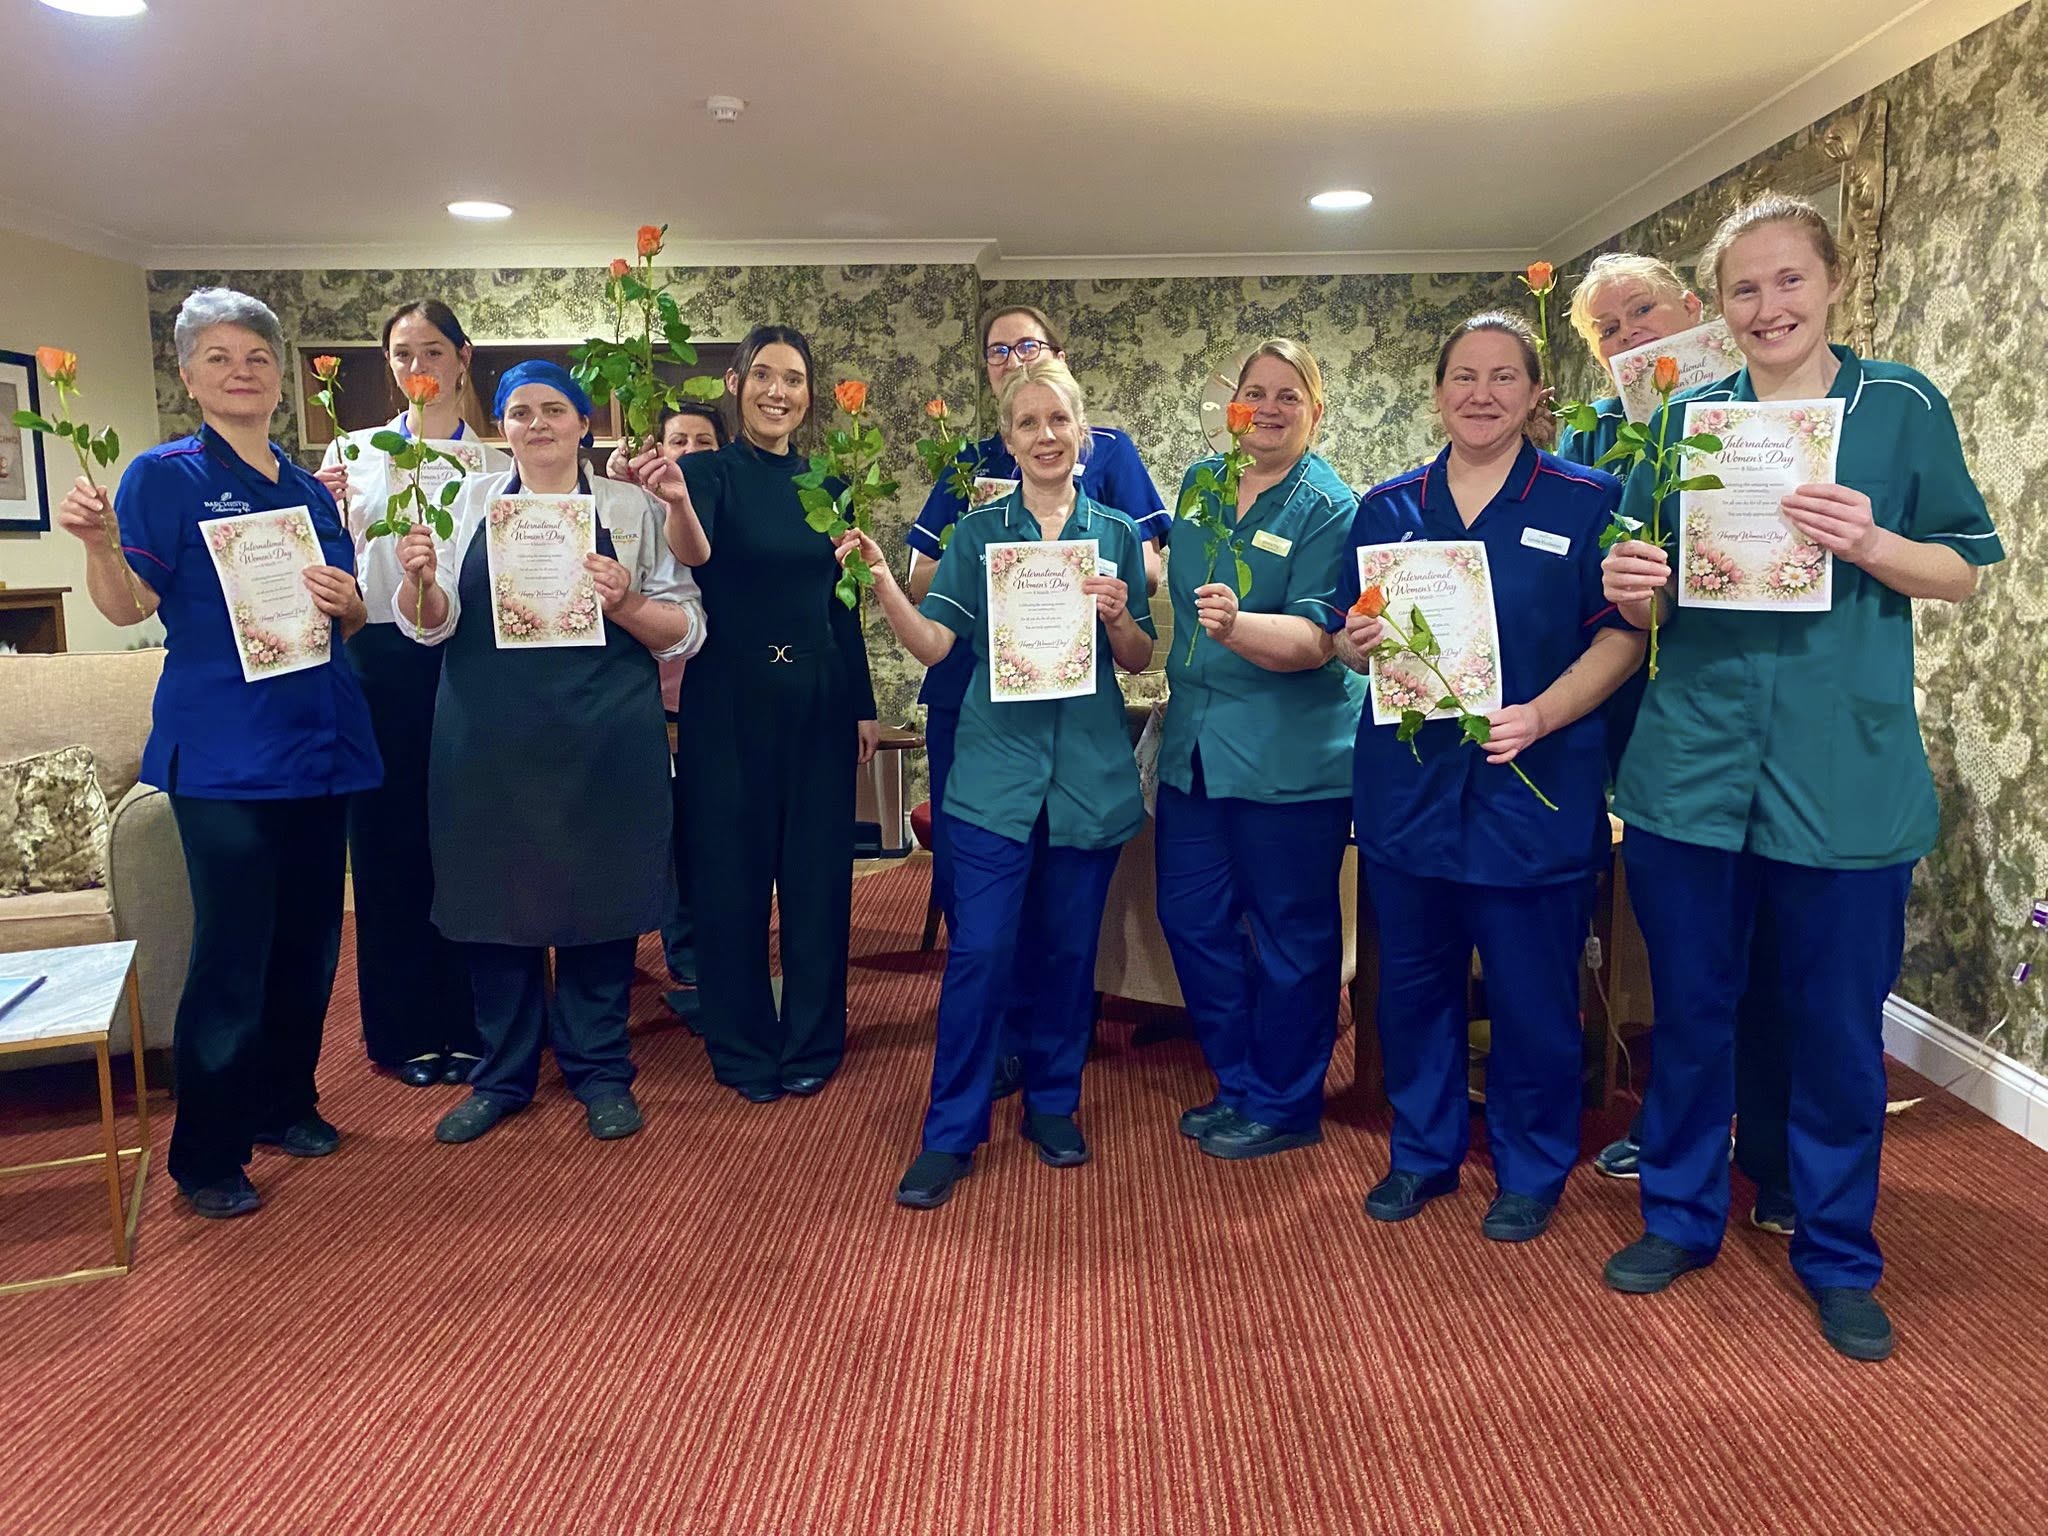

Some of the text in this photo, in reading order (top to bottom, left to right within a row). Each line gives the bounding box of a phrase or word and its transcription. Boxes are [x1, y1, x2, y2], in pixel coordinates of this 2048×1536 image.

[1679, 356, 1706, 374] ational
[1723, 434, 1794, 449] International
[1715, 449, 1795, 469] Women's Day
[513, 519, 562, 531] International
[511, 530, 565, 544] Women's Day
[1717, 530, 1788, 543] Happy Women's Day!
[240, 536, 286, 556] International
[240, 547, 293, 565] Women's Day
[1014, 567, 1067, 580] International
[1391, 568, 1453, 584] International
[1013, 578, 1070, 592] Women's Day
[1391, 580, 1457, 596] Women's Day
[1018, 640, 1034, 649] Happy
